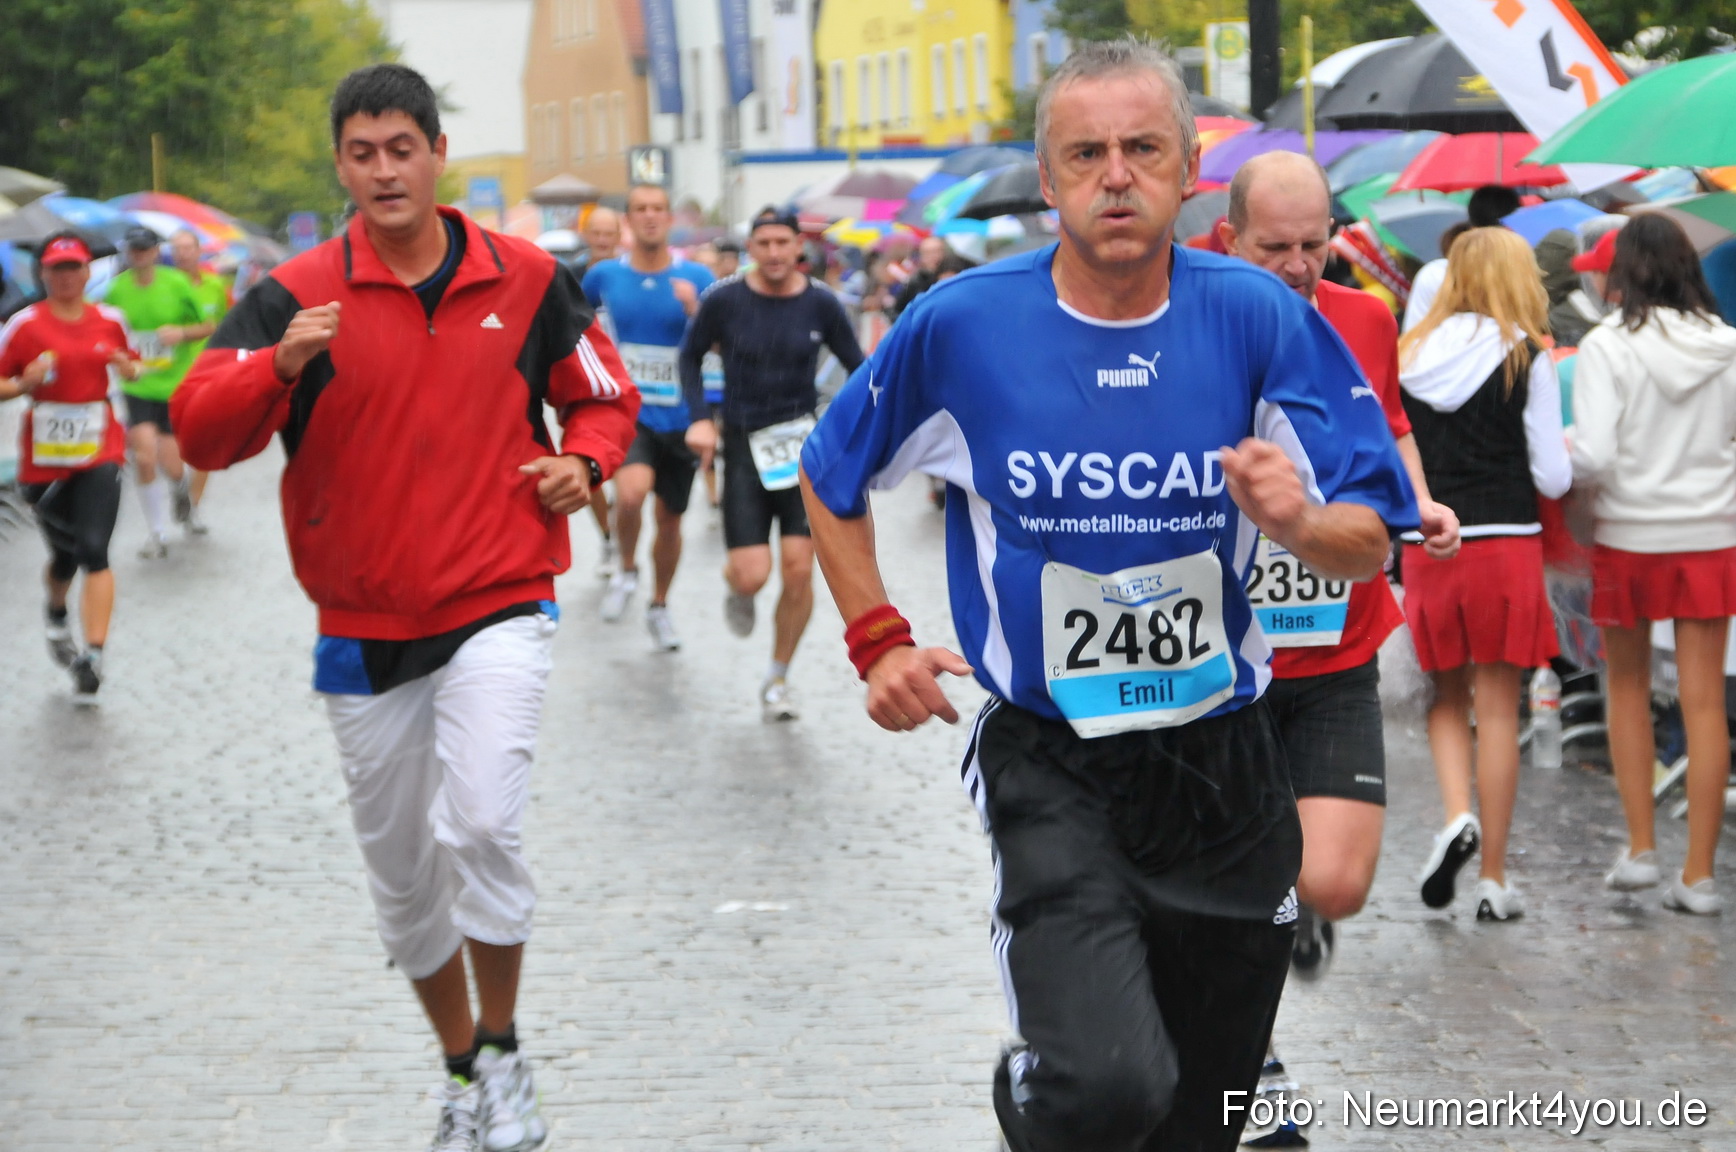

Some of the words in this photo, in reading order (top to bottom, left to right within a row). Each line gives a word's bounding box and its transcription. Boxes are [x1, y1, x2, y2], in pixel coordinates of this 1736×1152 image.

[1097, 369, 1149, 388] PUMA
[47, 417, 88, 442] 297
[1007, 450, 1226, 500] SYSCAD
[1019, 511, 1226, 533] www.metallbau-cad.de
[1272, 613, 1315, 629] Hans
[1064, 597, 1211, 670] 2482
[1052, 665, 1061, 678] C
[1119, 679, 1174, 707] Emil
